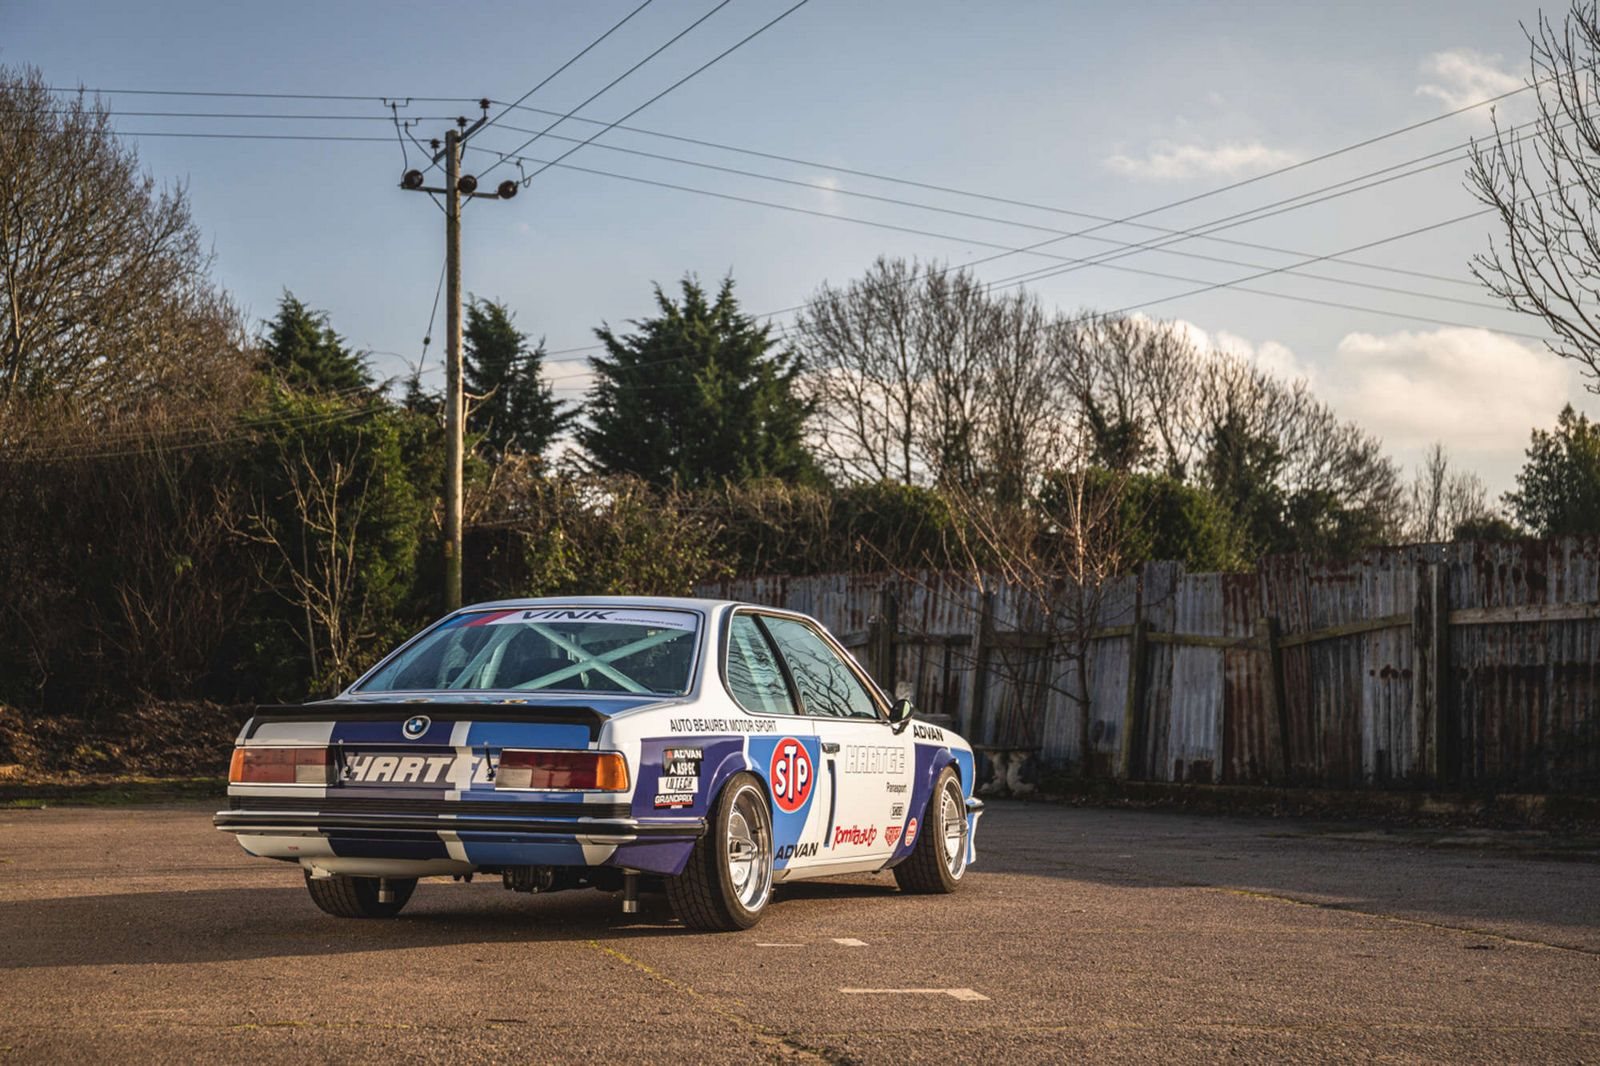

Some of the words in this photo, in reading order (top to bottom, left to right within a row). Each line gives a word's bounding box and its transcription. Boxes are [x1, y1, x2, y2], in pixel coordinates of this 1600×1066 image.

[522, 611, 614, 620] VINK
[670, 719, 692, 732] AUTO
[694, 719, 729, 732] BEAUREX
[729, 720, 753, 732] MOTOR
[755, 720, 777, 732] SPORT
[913, 725, 944, 741] ADVAN
[673, 750, 702, 759] ADVAN
[845, 745, 904, 774] HARTGE
[775, 745, 809, 803] STP
[654, 794, 693, 804] GRANDPRIX
[774, 842, 819, 861] ADVAN
